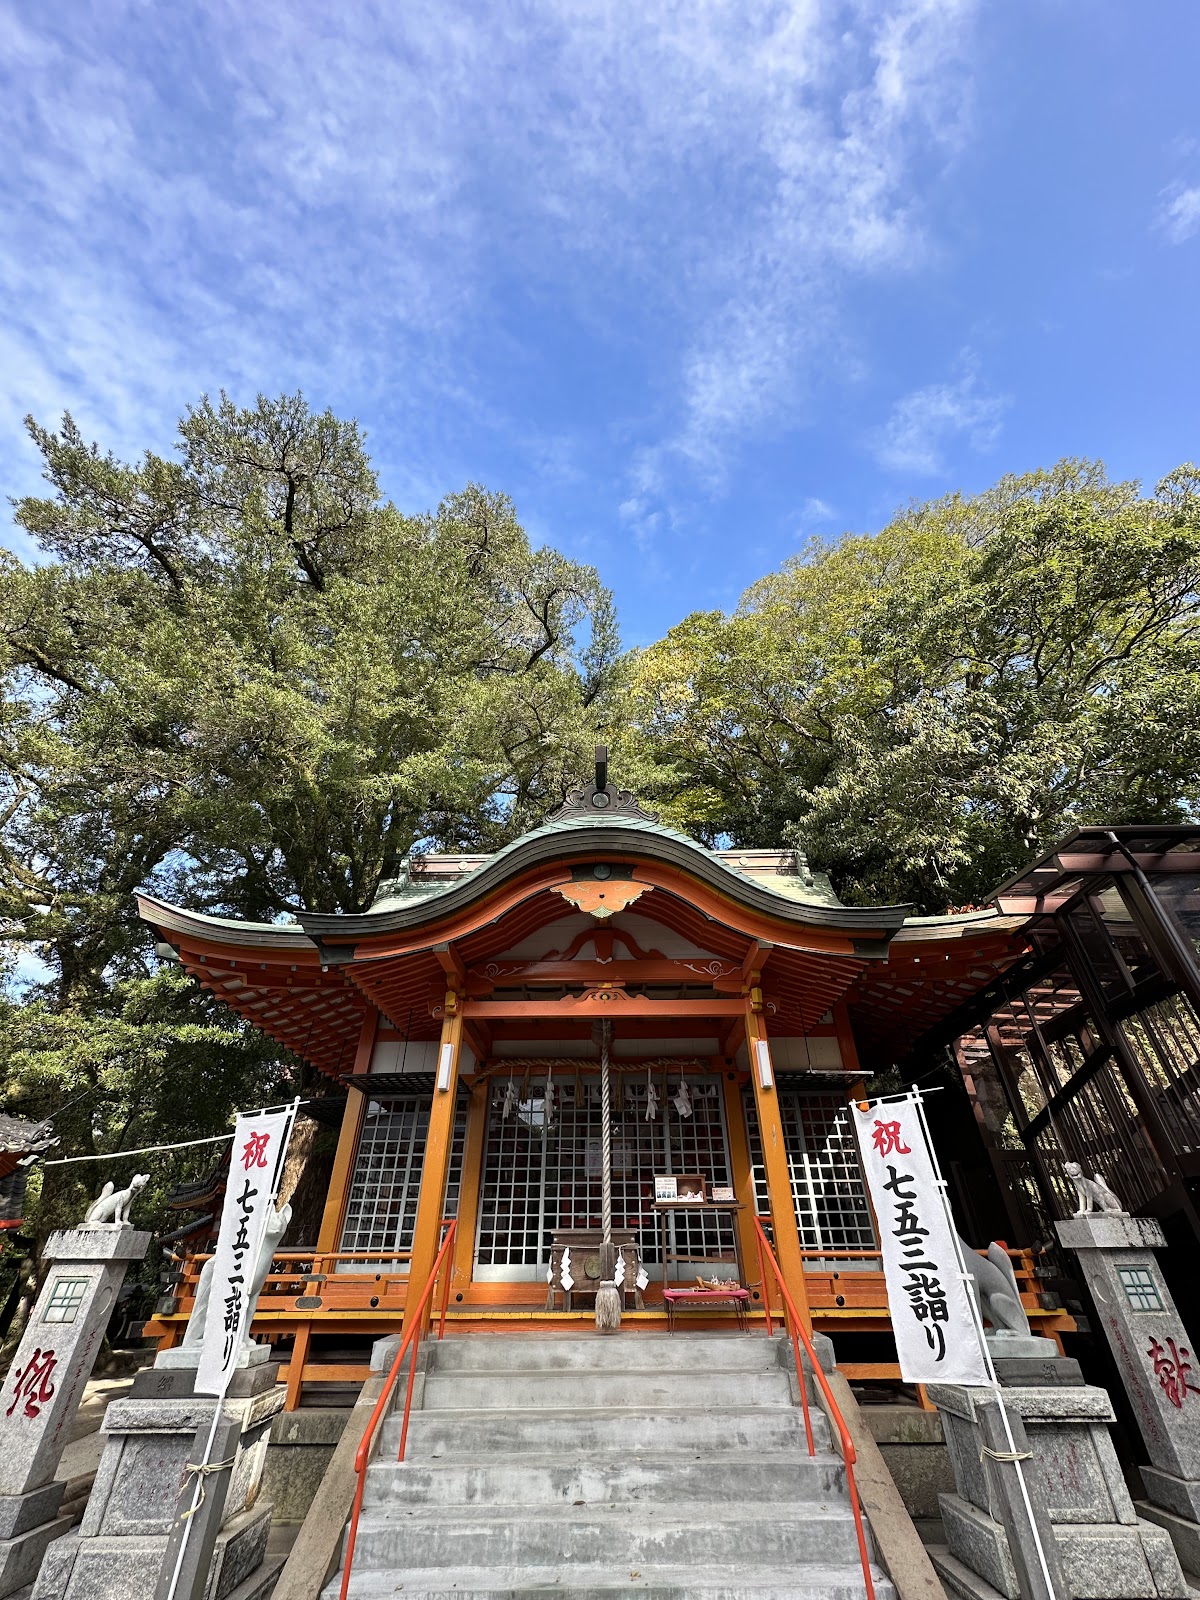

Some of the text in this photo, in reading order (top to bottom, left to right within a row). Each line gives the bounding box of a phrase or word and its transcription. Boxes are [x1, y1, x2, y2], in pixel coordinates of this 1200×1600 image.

[222, 1132, 271, 1372] 祝 七五三詣り
[872, 1120, 949, 1362] 祝 七五三詣り
